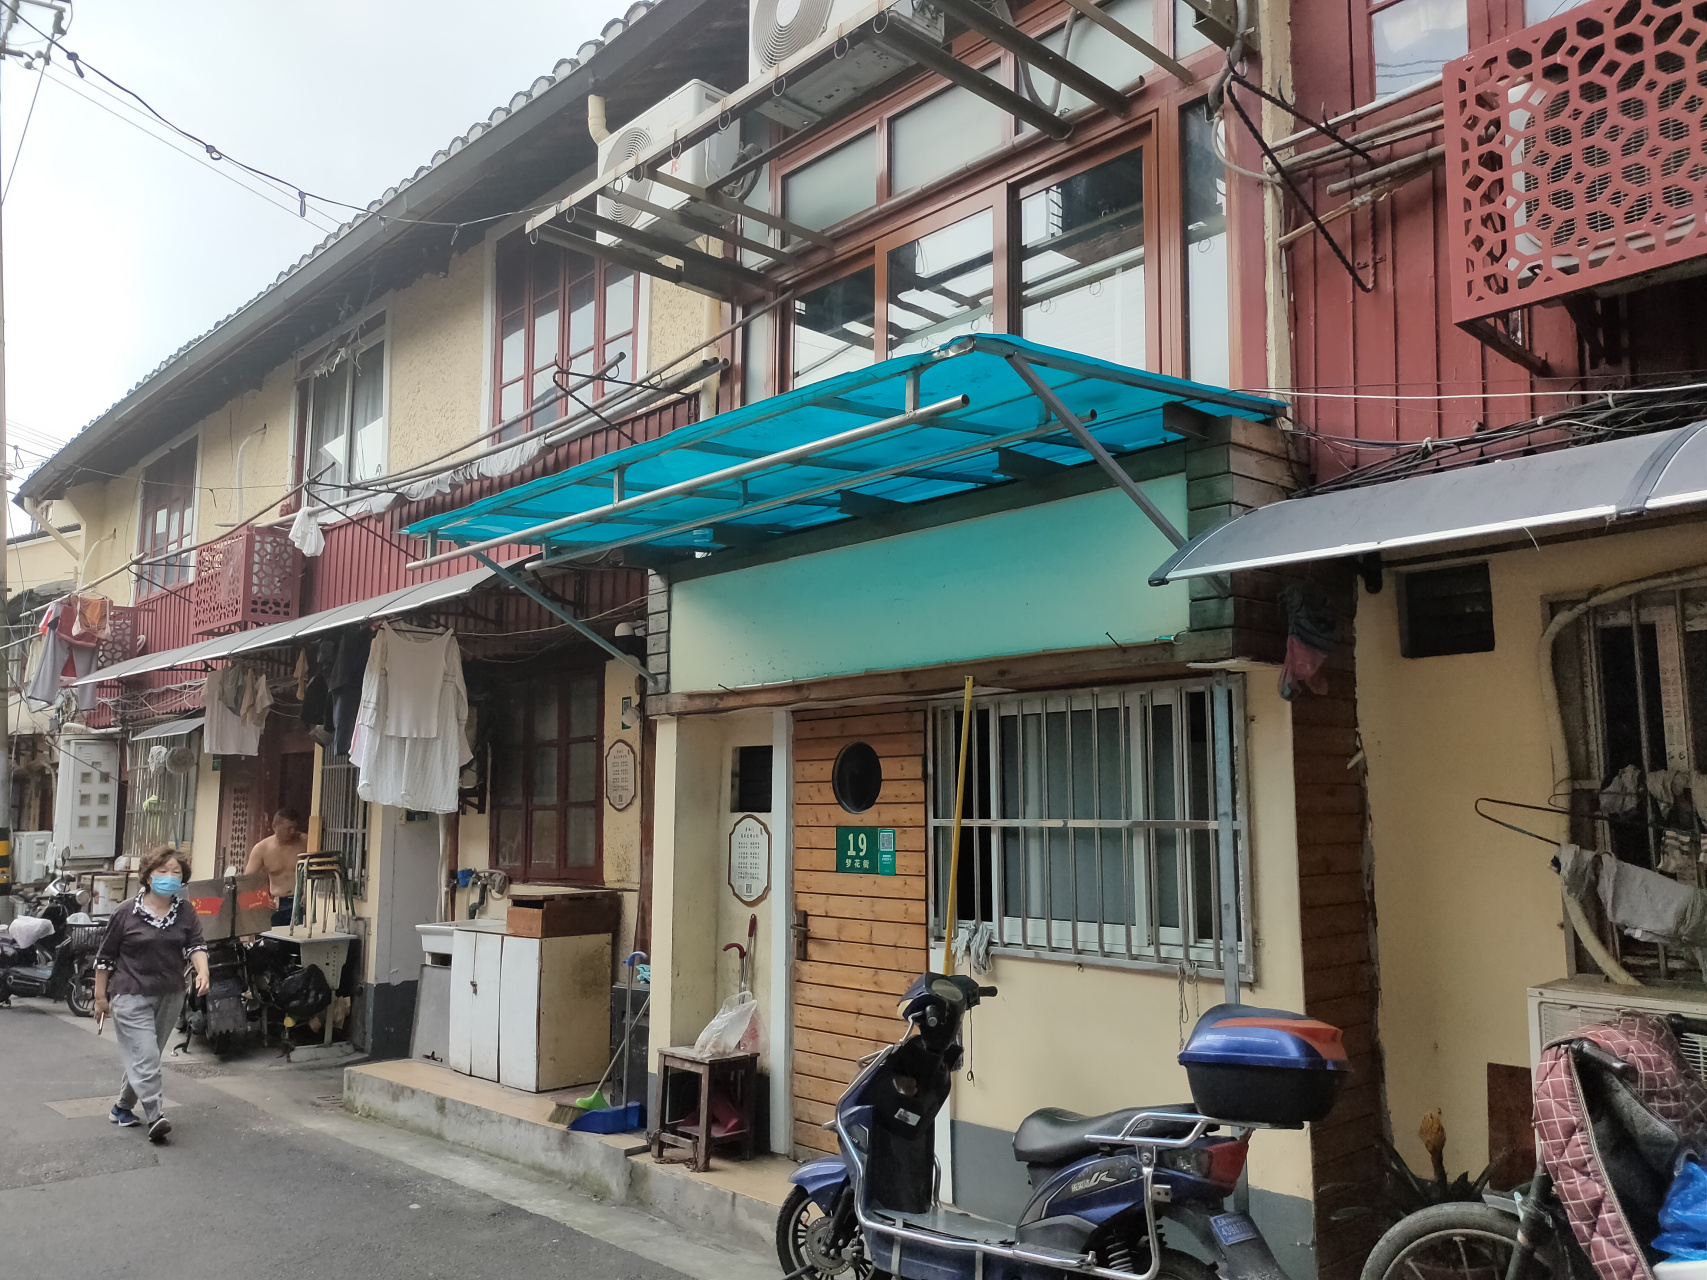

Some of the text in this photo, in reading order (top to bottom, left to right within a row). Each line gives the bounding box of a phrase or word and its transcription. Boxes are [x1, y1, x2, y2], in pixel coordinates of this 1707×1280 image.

[848, 833, 867, 856] 19
[845, 858, 870, 869] 梦花街
